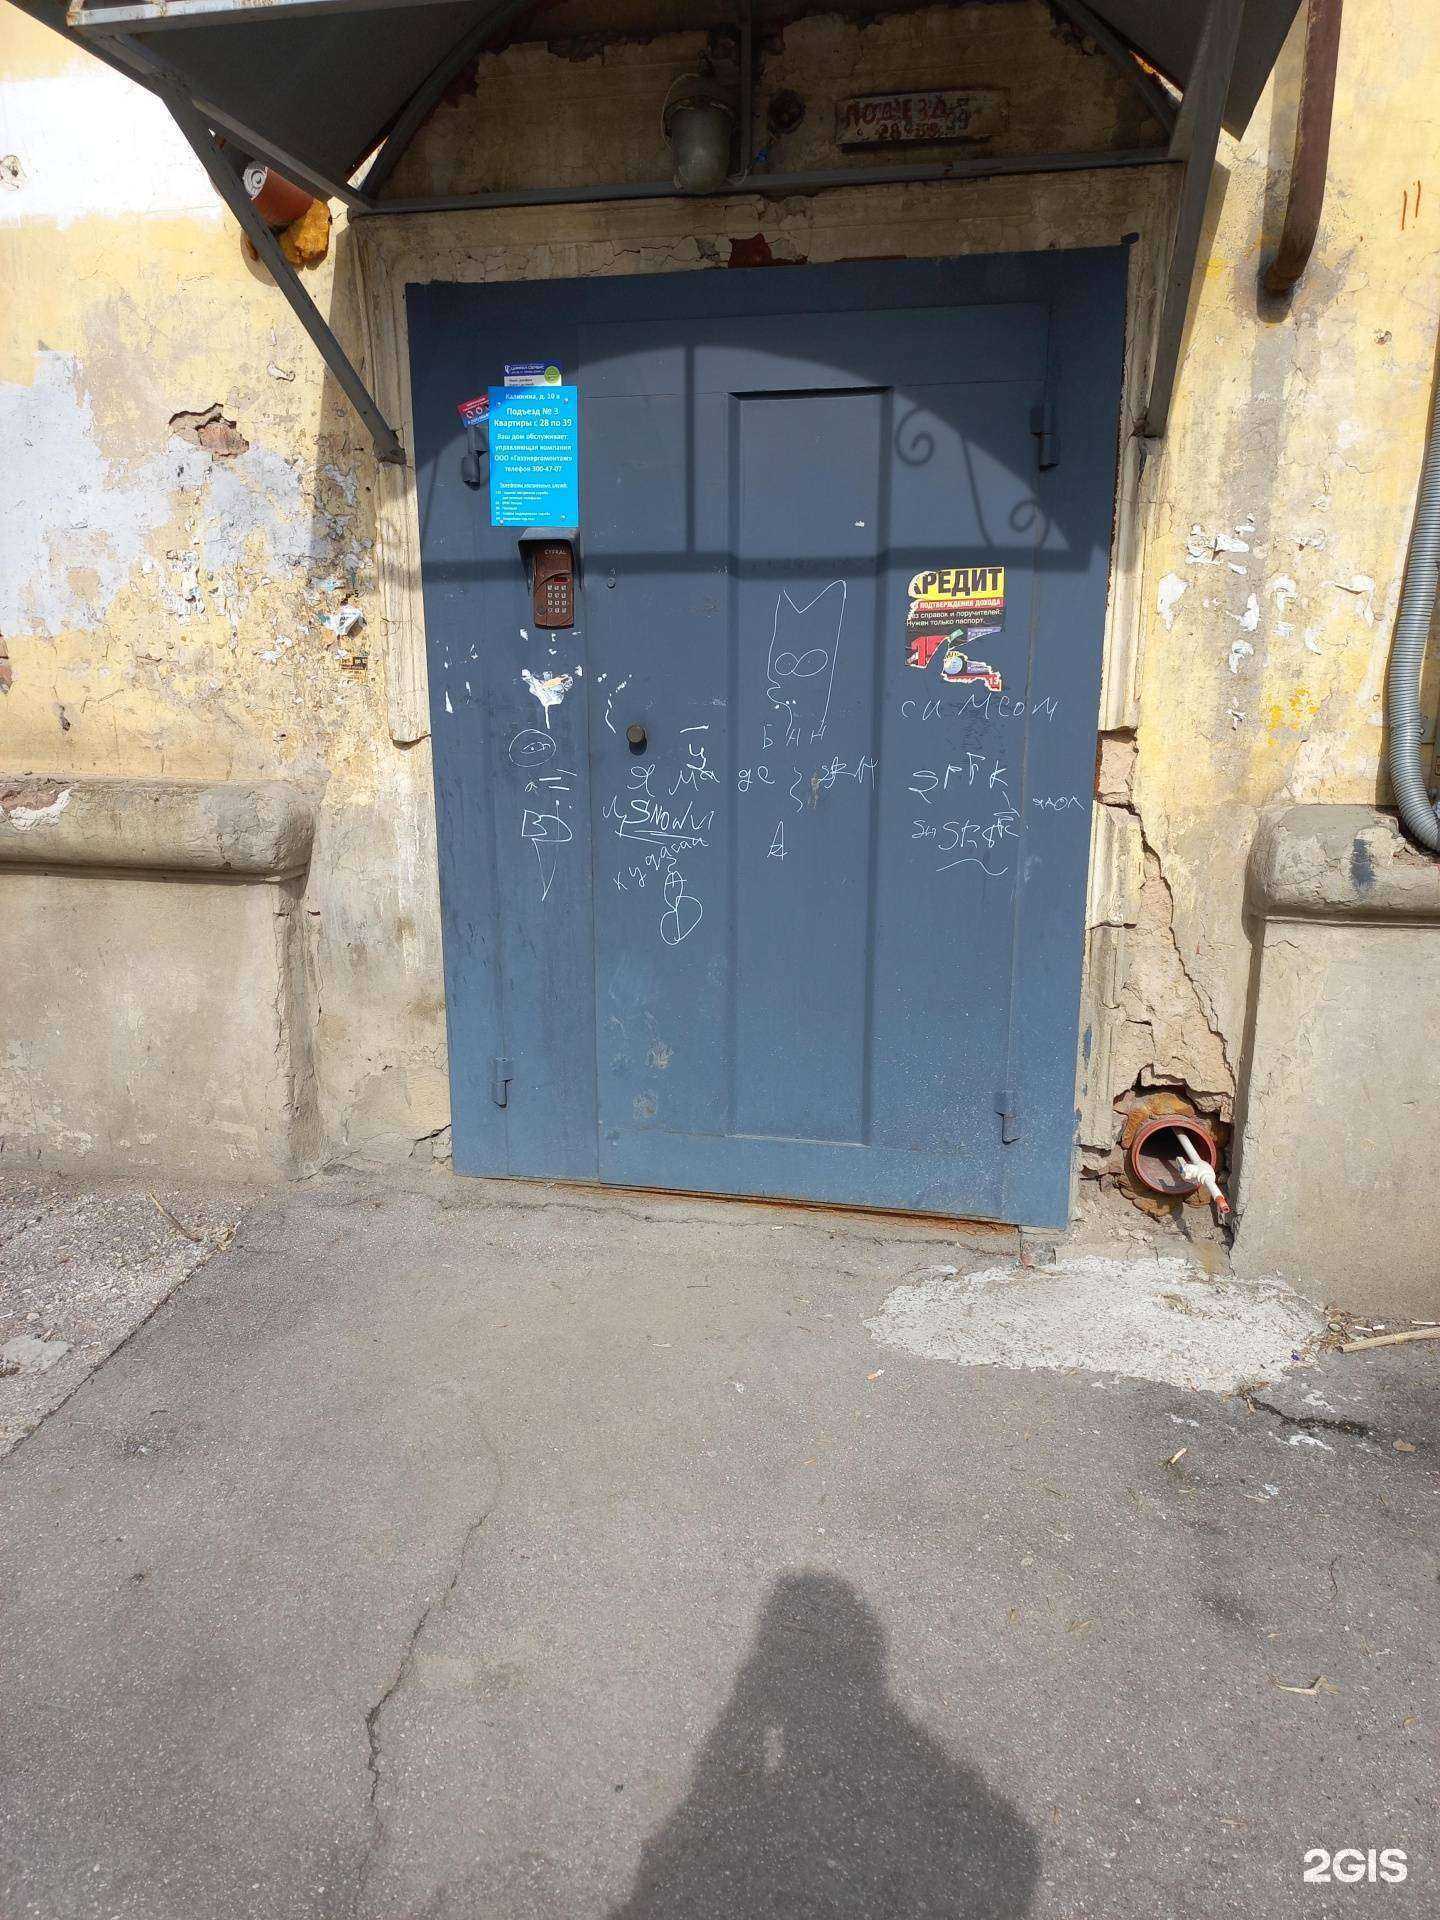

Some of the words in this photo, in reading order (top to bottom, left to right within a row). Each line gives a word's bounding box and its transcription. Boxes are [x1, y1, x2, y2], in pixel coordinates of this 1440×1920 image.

[506, 407, 541, 416] Подъезд
[542, 407, 552, 415] №
[553, 407, 559, 415] 3
[494, 419, 532, 428] Квартиры
[540, 419, 549, 427] 28
[562, 419, 572, 427] 39
[913, 568, 1002, 597] РЕДИТ
[975, 598, 1001, 607] ДОХОДА
[906, 619, 928, 627] Нужен
